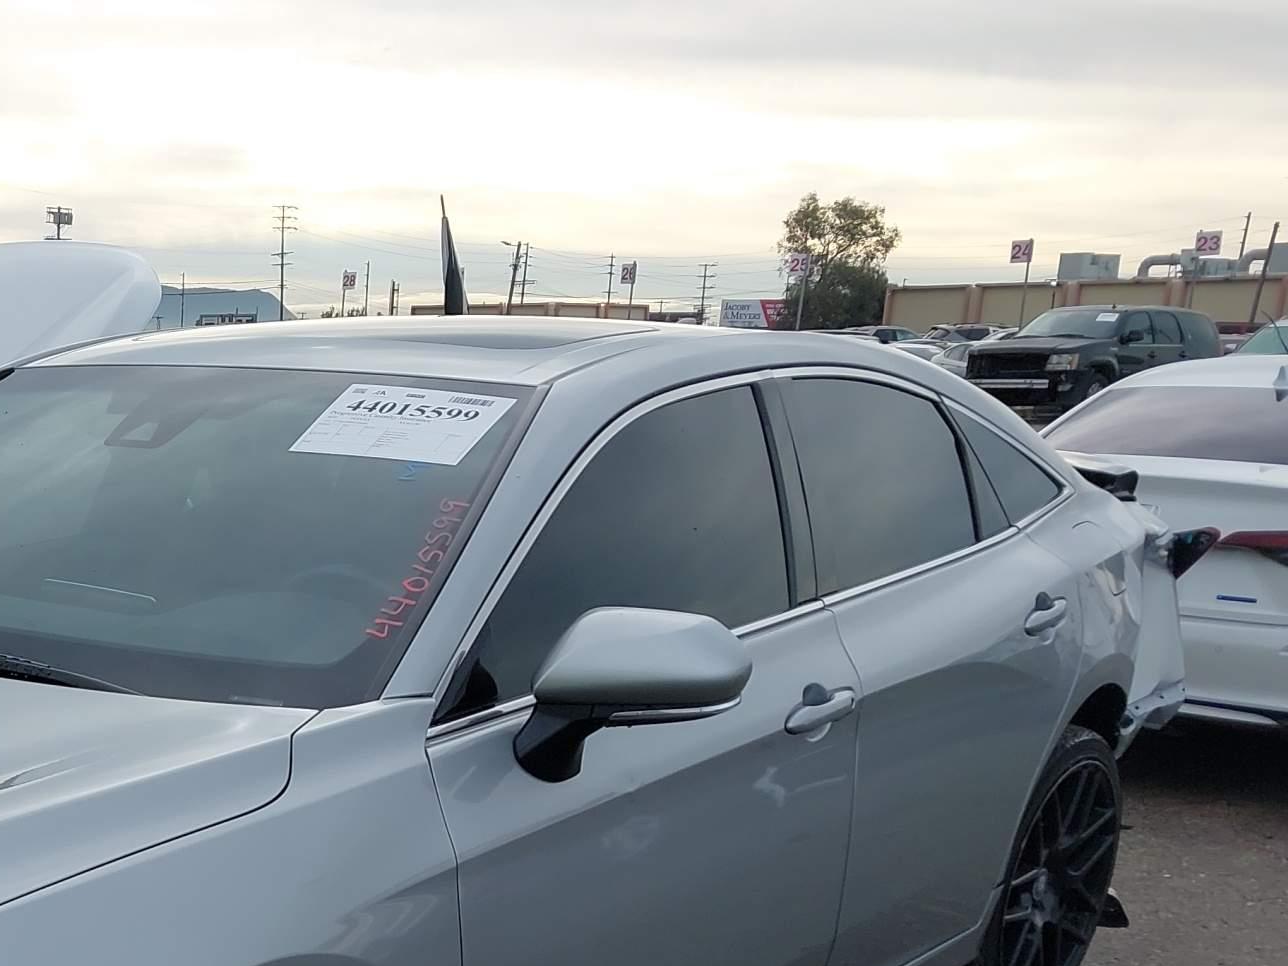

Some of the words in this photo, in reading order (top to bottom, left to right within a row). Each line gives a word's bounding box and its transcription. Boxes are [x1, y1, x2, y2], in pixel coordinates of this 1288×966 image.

[1197, 235, 1221, 251] 23
[1011, 244, 1031, 260] 24
[343, 275, 356, 287] 28
[346, 399, 480, 421] 44015599
[365, 498, 471, 638] 44015599
